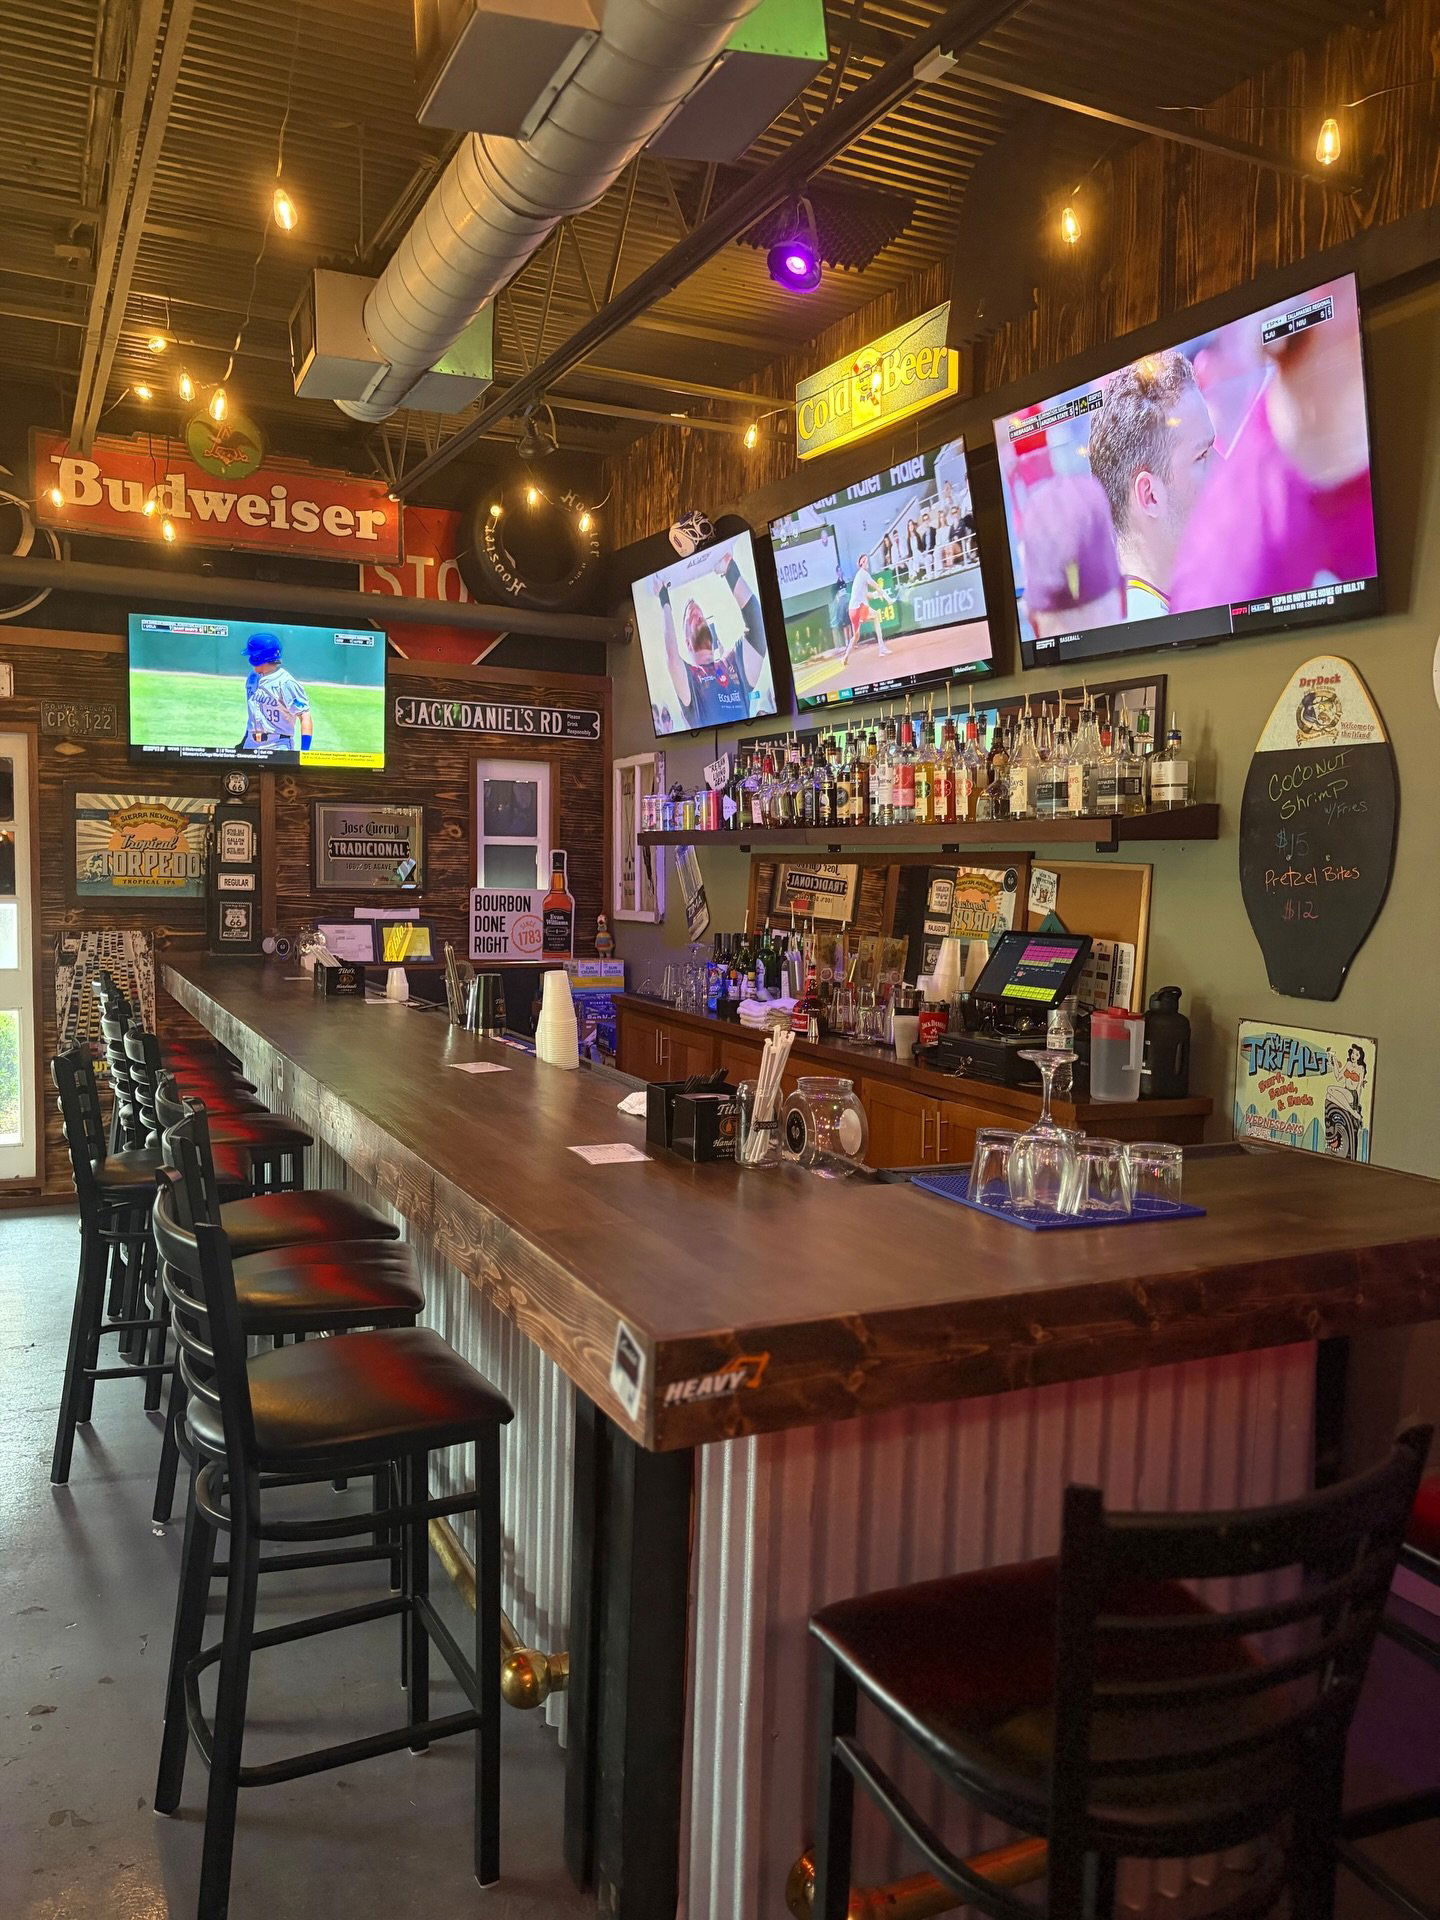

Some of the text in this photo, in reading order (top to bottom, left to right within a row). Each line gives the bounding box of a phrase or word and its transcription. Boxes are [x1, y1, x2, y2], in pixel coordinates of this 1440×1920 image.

[798, 347, 948, 440] Cold Beer
[50, 455, 386, 541] Budweiser
[484, 524, 527, 596] Hoosier
[913, 587, 974, 622] Emirates
[1060, 634, 1081, 643] BASEBALL
[1299, 673, 1341, 688] DryDock
[265, 708, 280, 723] 39
[405, 701, 562, 734] JACK DANIEL'S RD
[567, 729, 591, 737] Responsibly
[1269, 749, 1353, 801] COCONUT
[232, 783, 243, 791] 66
[120, 811, 179, 824] SIERRA NEVADA
[340, 820, 400, 836] Jose Cuervo
[120, 834, 179, 851] Tropical
[333, 842, 406, 857] TRADICIONAL
[97, 850, 201, 878] TORPEDO
[224, 878, 249, 887] REGULAR
[1265, 866, 1360, 890] Pretzel Bites
[474, 894, 531, 912] BOURBON
[230, 919, 242, 927] 66
[474, 915, 506, 933] DONE
[474, 936, 509, 953] RIGHT
[518, 930, 542, 946] 1783
[1266, 1032, 1293, 1053] THE
[1242, 1037, 1328, 1079] TIKI HUT
[1258, 1072, 1285, 1093] Surf,
[1268, 1081, 1298, 1100] Sand,
[1277, 1094, 1314, 1111] & Suds
[1245, 1113, 1305, 1136] WEDNESDAYS
[663, 1365, 748, 1408] HEAVY
